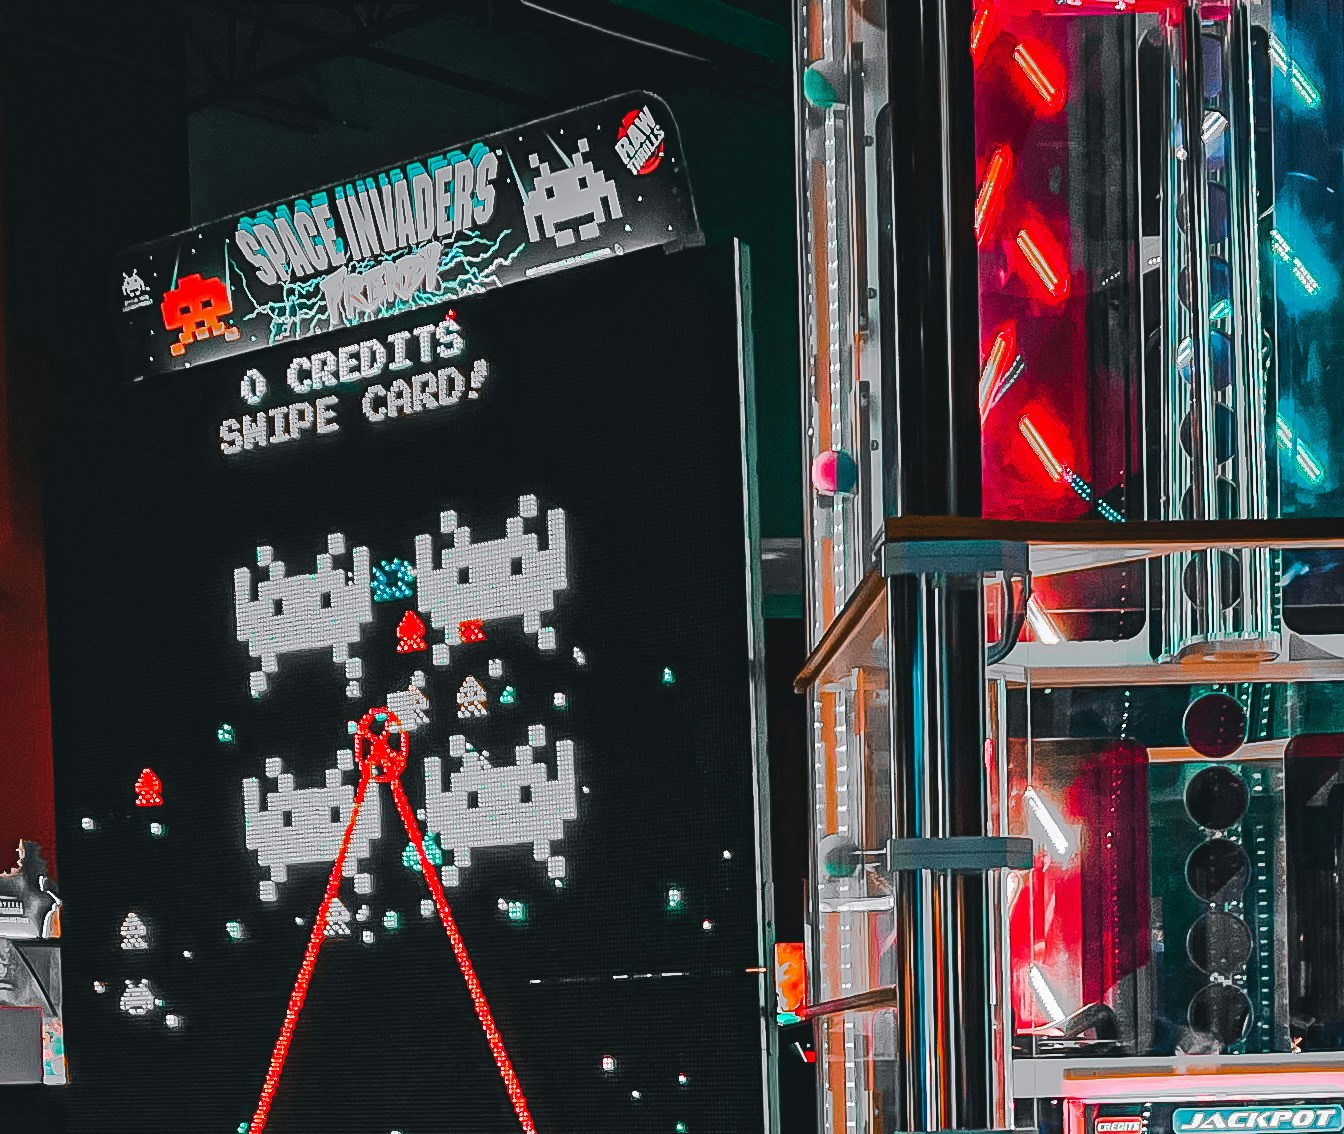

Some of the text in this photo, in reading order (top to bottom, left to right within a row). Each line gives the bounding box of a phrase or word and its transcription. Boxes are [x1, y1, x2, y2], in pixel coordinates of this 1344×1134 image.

[615, 105, 656, 165] RAW
[627, 124, 665, 176] THRILLS
[235, 148, 499, 286] SPACE INVADERS
[319, 241, 444, 325] FRENZY
[286, 319, 466, 394] CREDITS
[220, 358, 489, 455] SWIPE CARD!
[1181, 1109, 1336, 1131] JACKPOT
